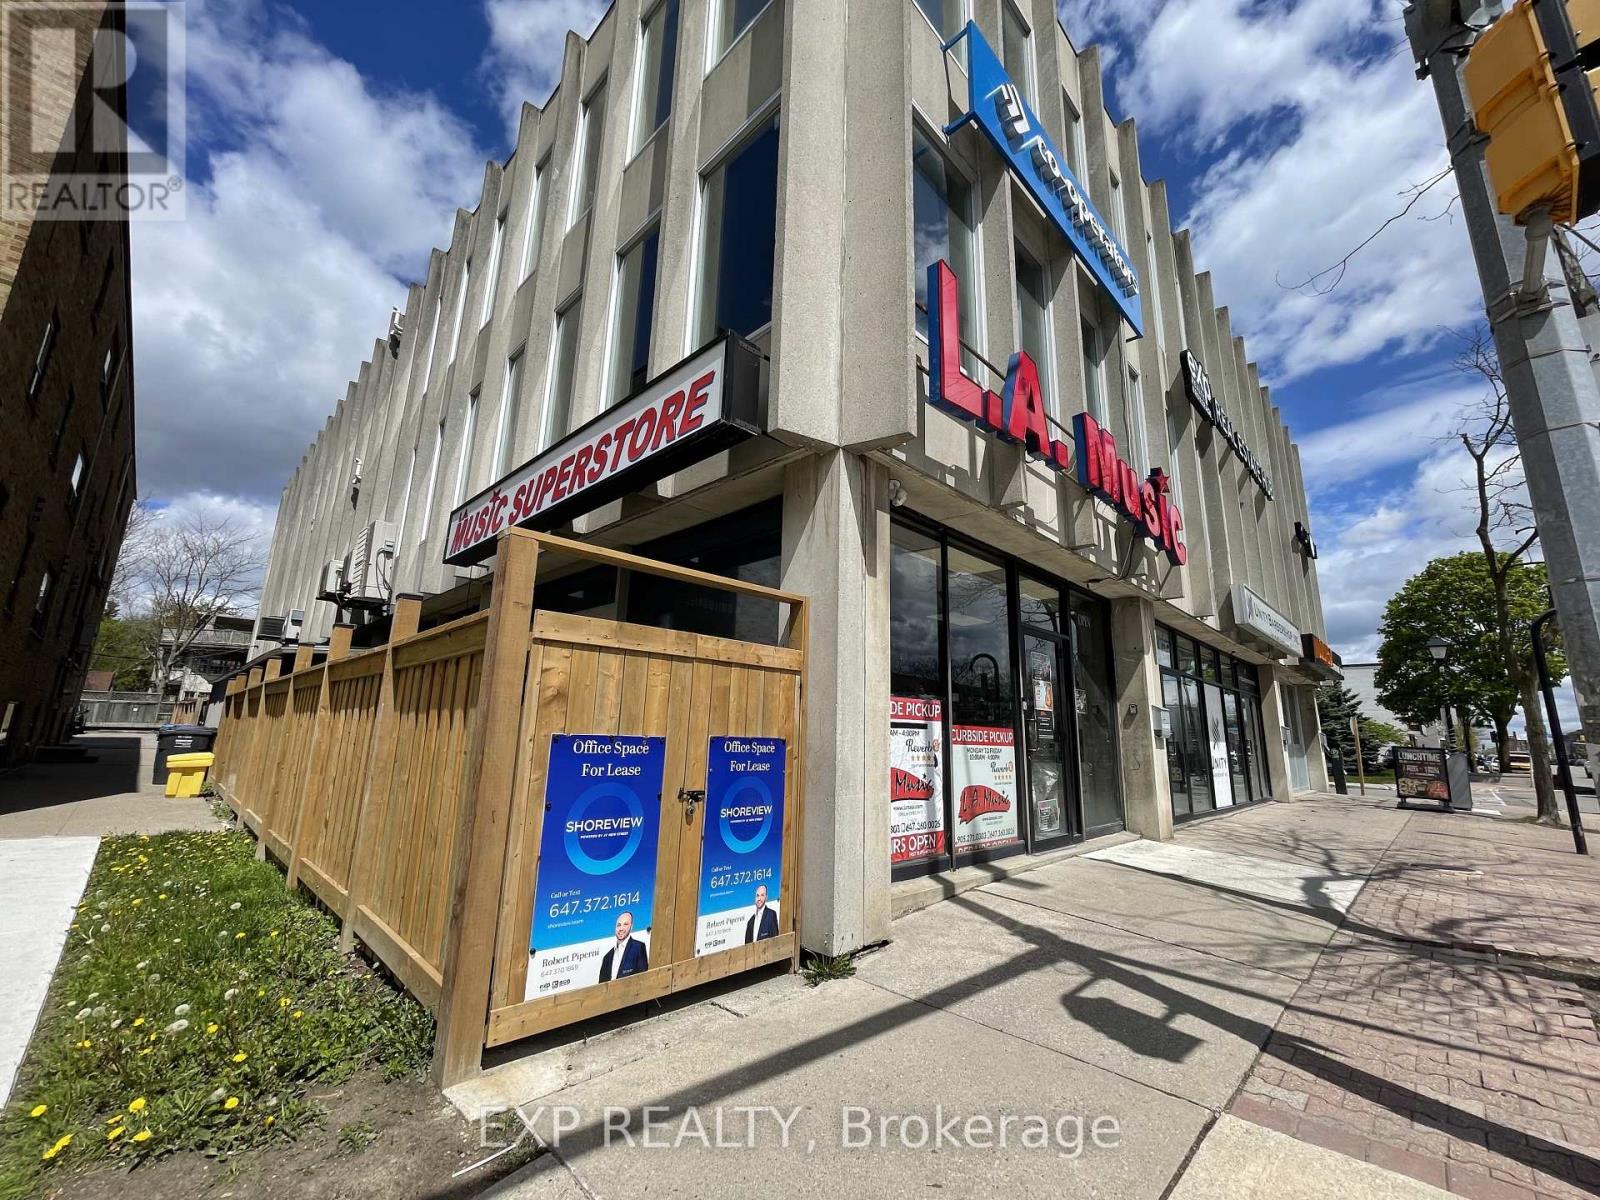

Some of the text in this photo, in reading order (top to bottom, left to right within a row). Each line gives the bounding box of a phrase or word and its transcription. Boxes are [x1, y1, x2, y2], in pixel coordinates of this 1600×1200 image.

[1033, 135, 1139, 297] co-operators
[930, 258, 1068, 471] L.A.
[508, 370, 716, 526] SUPERSTORE
[905, 702, 941, 718] PICKUP
[952, 729, 1014, 744] CURBSIDE PICKUP
[573, 739, 649, 757] Office Space
[724, 741, 776, 756] Office Space
[1397, 751, 1441, 763] LUNCHTIME
[581, 763, 641, 777] For Lease
[730, 760, 770, 772] For Lease
[720, 805, 773, 818] SHOREVIEW
[566, 816, 643, 833] SHOREVIEW
[908, 833, 936, 851] OPEN
[710, 868, 773, 889] 647.372.1614
[549, 890, 640, 918] 647.372.1614
[542, 955, 570, 967] Robert
